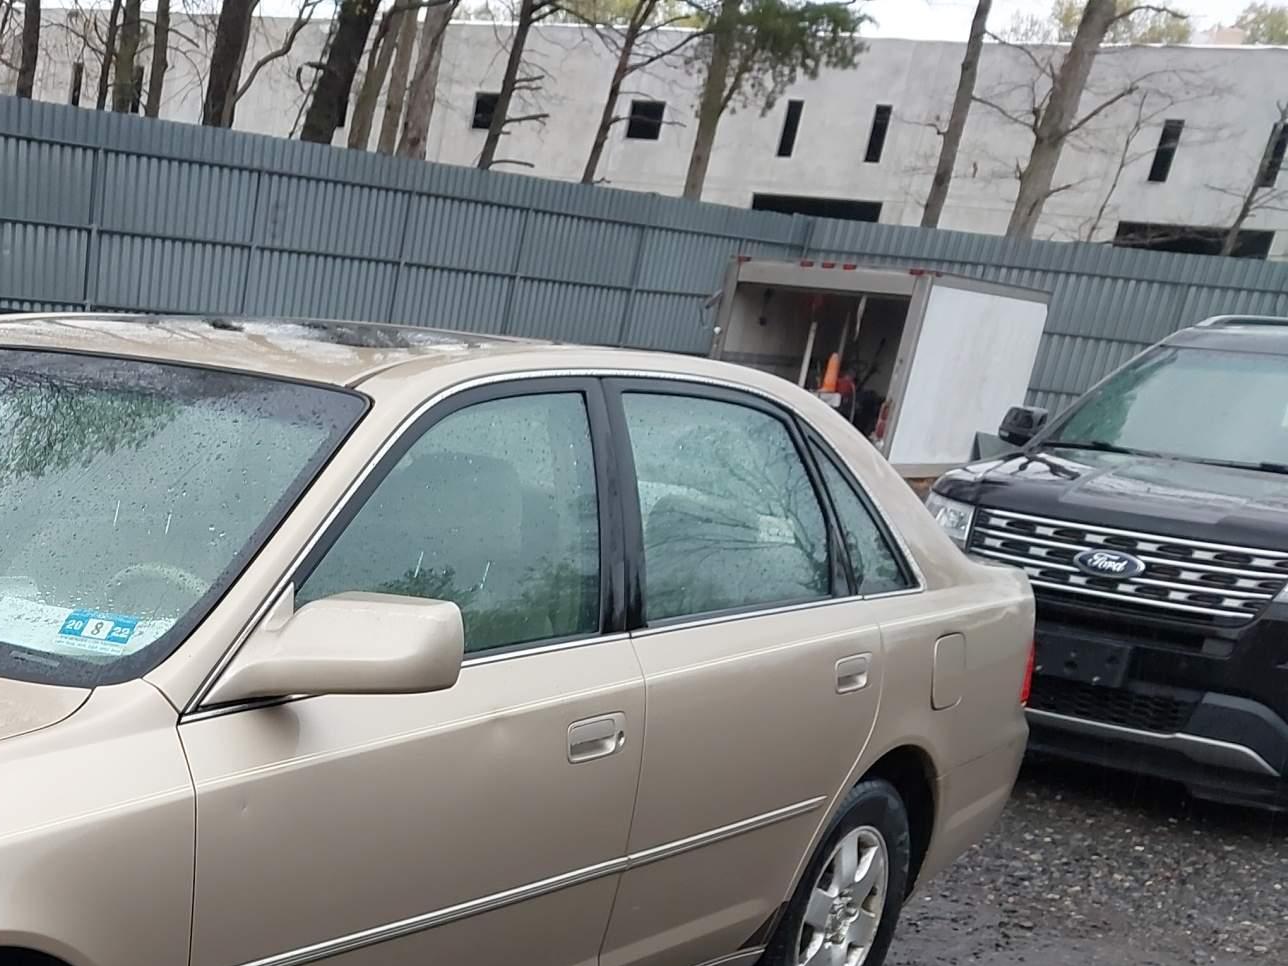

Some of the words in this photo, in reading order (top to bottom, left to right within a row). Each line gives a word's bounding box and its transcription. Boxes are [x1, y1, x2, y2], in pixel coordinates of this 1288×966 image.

[1087, 552, 1128, 572] Ford
[66, 619, 84, 630] 20
[91, 621, 104, 635] 8
[112, 626, 130, 637] 22
